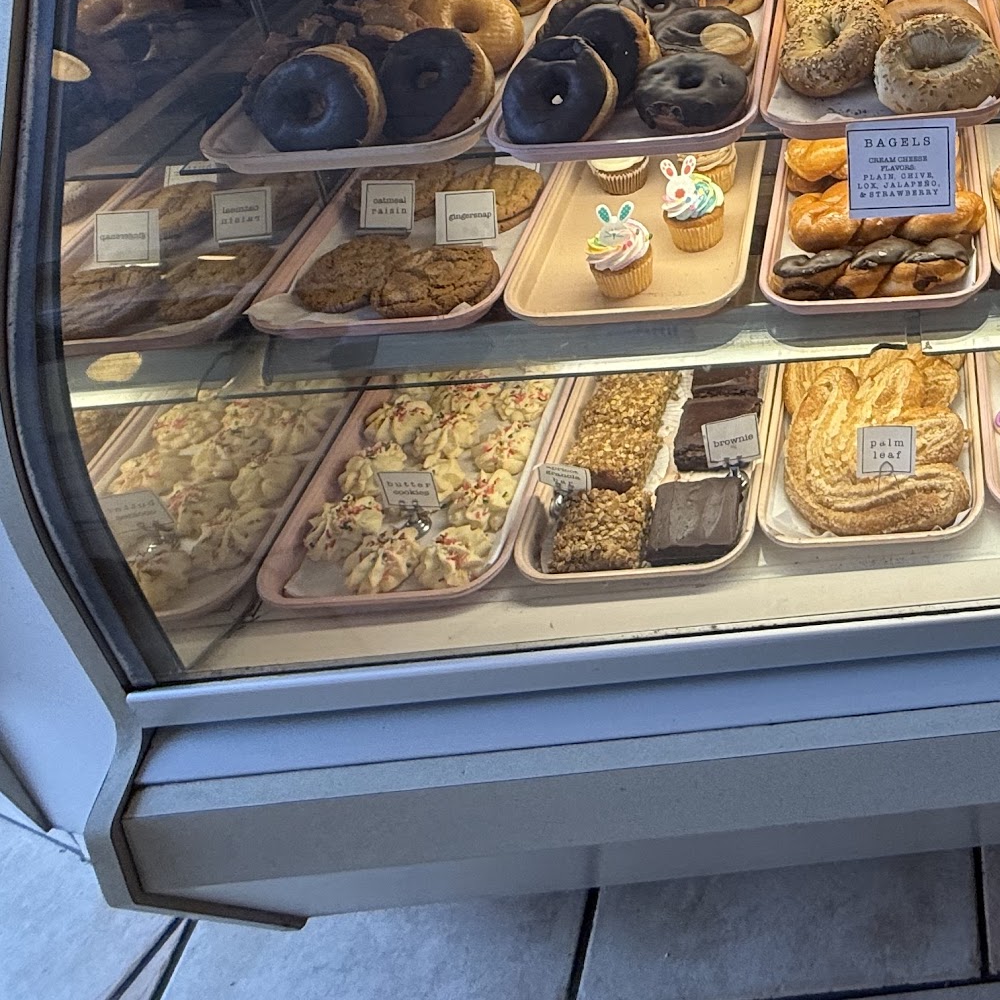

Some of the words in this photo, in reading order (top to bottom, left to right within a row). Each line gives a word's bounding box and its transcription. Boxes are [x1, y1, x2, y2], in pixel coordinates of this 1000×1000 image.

[864, 136, 931, 148] BAGELS
[869, 189, 939, 198] STRAWBERRY
[448, 211, 492, 222] gingersnap
[713, 432, 754, 448] brownie
[870, 438, 904, 449] palm
[873, 451, 902, 459] leaf
[386, 480, 431, 489] butter
